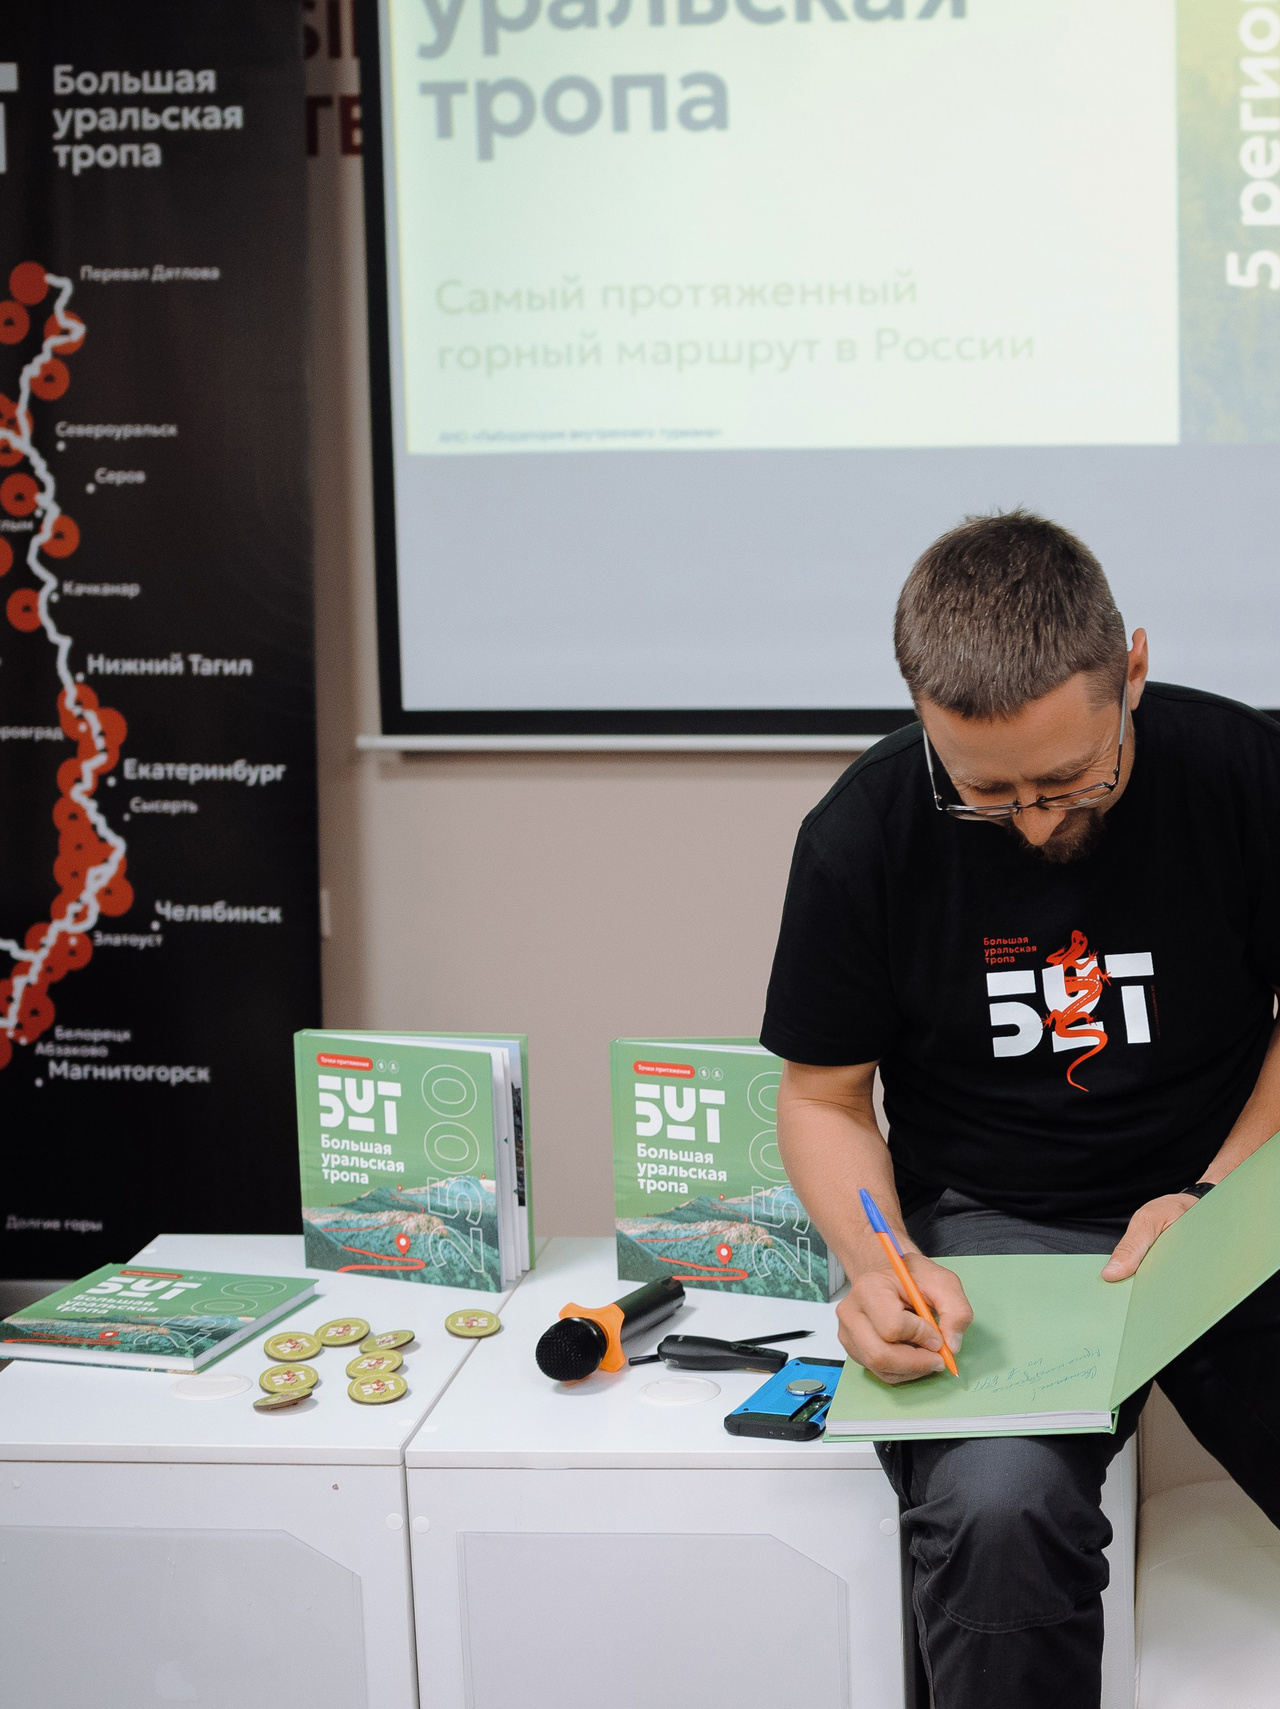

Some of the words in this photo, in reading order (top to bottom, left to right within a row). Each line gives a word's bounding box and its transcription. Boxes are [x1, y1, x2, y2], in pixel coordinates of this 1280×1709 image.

[53, 64, 216, 95] Большая
[52, 105, 244, 140] уральская
[417, 70, 730, 162] тропа
[52, 143, 162, 176] тропа
[435, 275, 586, 317] Самый
[602, 269, 919, 317] протяженный
[437, 331, 603, 376] горный
[616, 337, 822, 375] маршрут
[835, 331, 858, 364] в
[875, 326, 1035, 363] России
[55, 421, 178, 440] Североуральск
[95, 467, 146, 486] Серов
[63, 580, 140, 598] Качканар
[87, 652, 183, 676] Нижний
[188, 654, 253, 676] Тагил
[124, 758, 286, 786] Екатеринбург
[130, 796, 198, 815] Сысерть
[155, 900, 282, 925] Челябинск
[94, 931, 163, 948] Златоуст
[983, 936, 1029, 946] Большая
[984, 945, 1037, 957] уральская
[985, 956, 1016, 965] тропа
[54, 1026, 131, 1043] Белорецк
[49, 1060, 210, 1086] Магнитогорск
[320, 1134, 392, 1156] Большая
[637, 1143, 714, 1165] Большая
[321, 1152, 405, 1174] уральская
[637, 1162, 727, 1182] уральская
[321, 1167, 369, 1185] тропа
[637, 1178, 688, 1195] тропа
[55, 1305, 109, 1315] тропа
[64, 1300, 160, 1313] уральская
[73, 1294, 155, 1307] Большая
